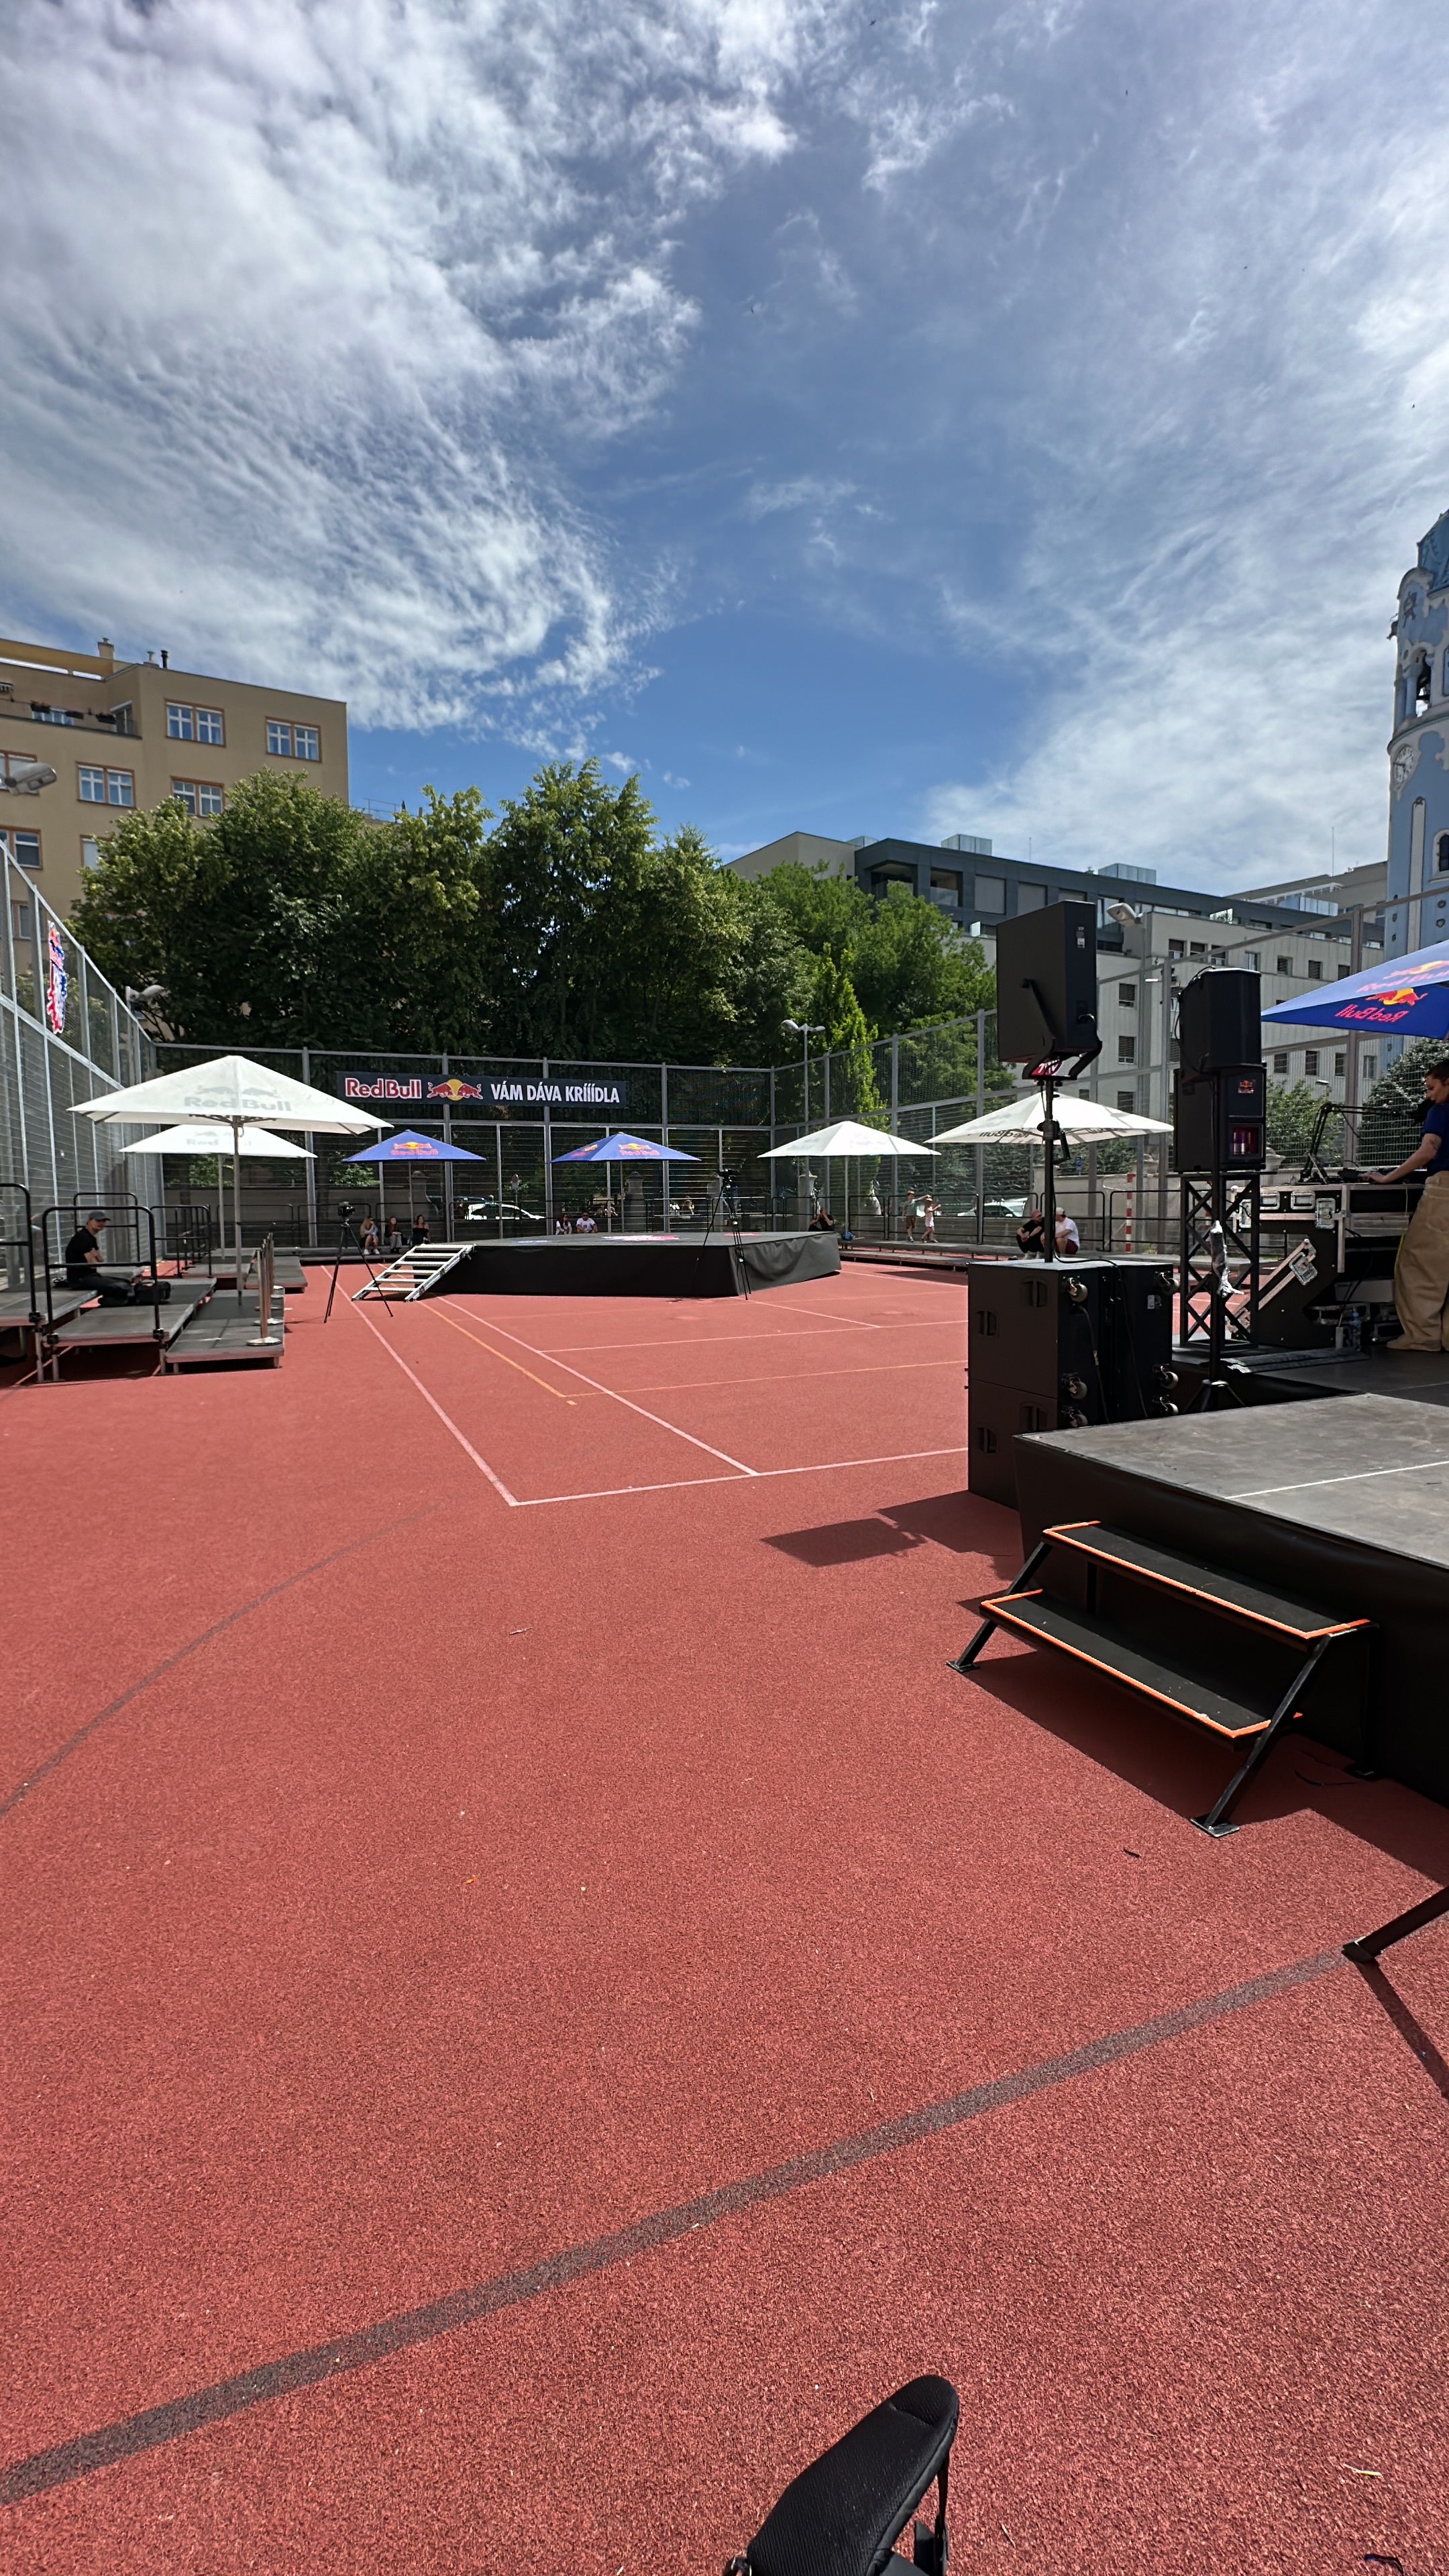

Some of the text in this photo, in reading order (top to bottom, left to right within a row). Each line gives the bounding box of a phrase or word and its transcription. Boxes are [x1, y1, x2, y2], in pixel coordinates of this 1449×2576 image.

[345, 1077, 620, 1104] Red Bull VÁM DÁVA KRÍÍÍDLA
[184, 1097, 292, 1112] Red Bull
